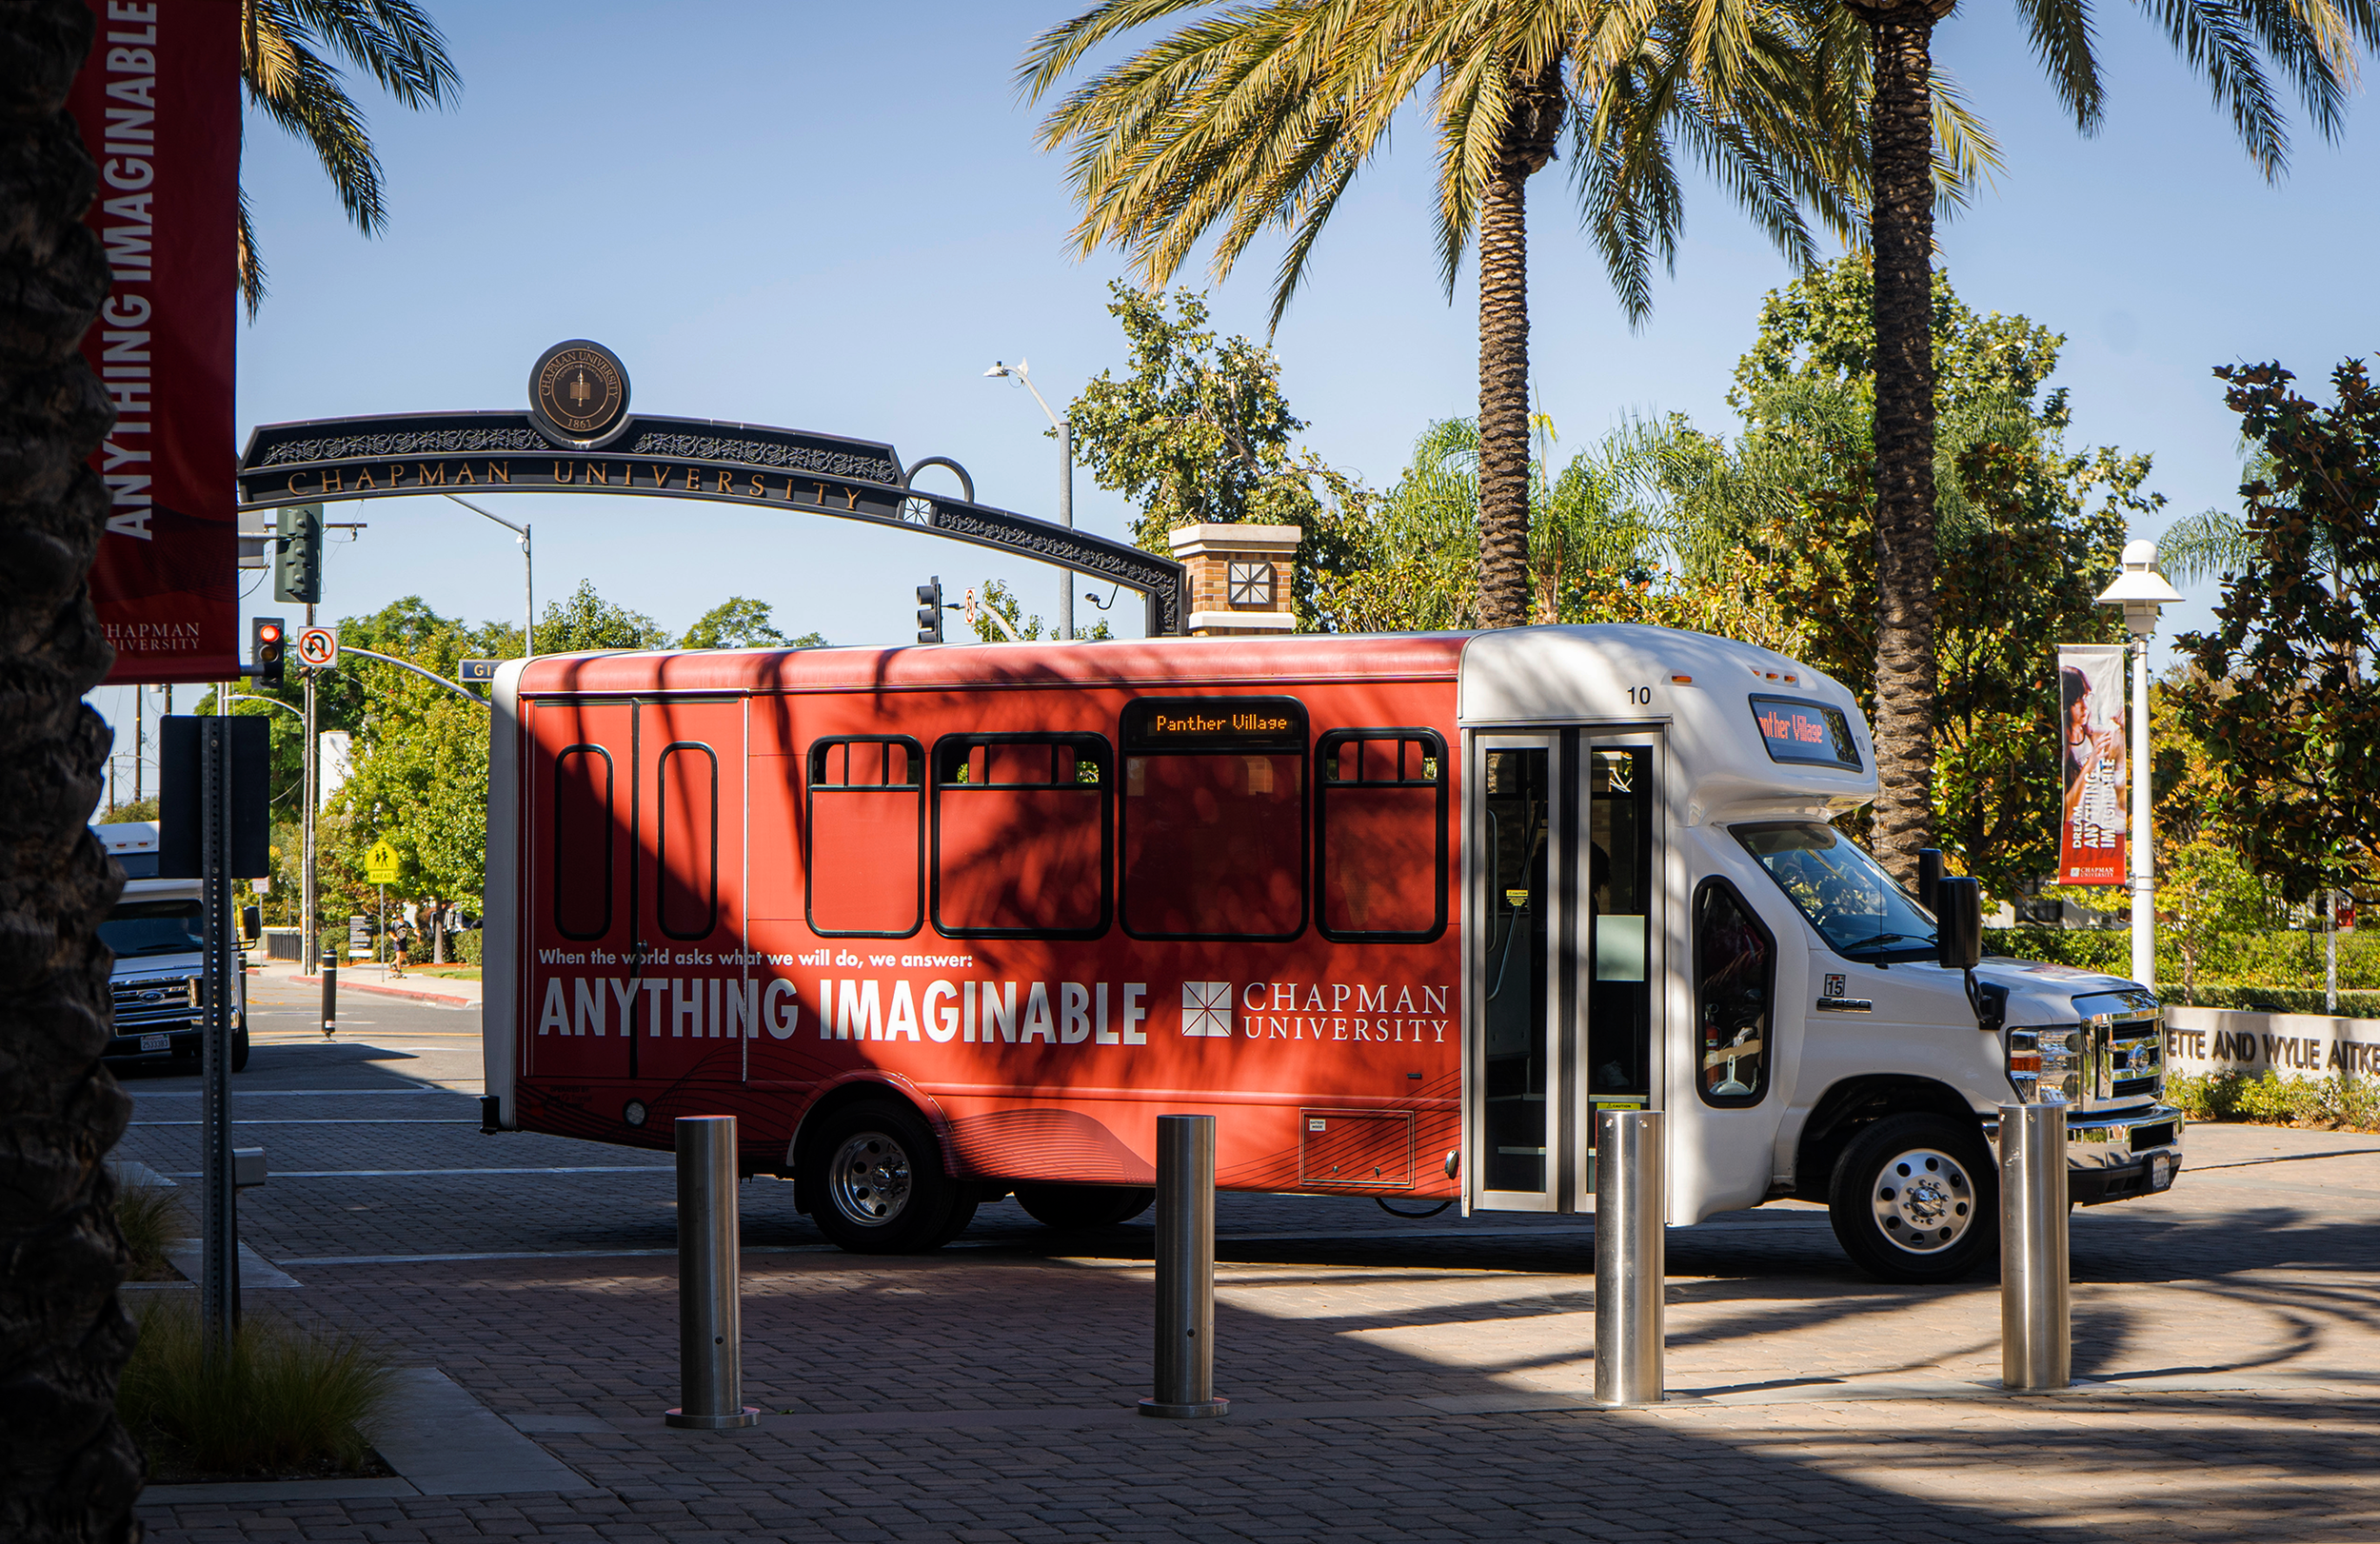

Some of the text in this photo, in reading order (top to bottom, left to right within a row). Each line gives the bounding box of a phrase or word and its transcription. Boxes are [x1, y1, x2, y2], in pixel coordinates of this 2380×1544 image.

[102, 0, 157, 541] ANYTHING IMAGINABLE
[541, 351, 577, 397] CHAPMAN
[579, 351, 619, 399] UNIVERSITY
[567, 419, 592, 428] 1861
[288, 461, 862, 510] CHAPMAN UNIVERSITY
[99, 623, 200, 638] HAPMAN
[106, 638, 200, 651] NIVERSITY
[1627, 686, 1652, 705] 10
[1157, 714, 1288, 732] Panther Village
[1792, 714, 1823, 743] Village
[2084, 771, 2099, 848] ANYTHING
[2100, 758, 2116, 848] IMAGINABLE
[2073, 806, 2083, 848] DREAM
[539, 948, 973, 969] When the world asks what we will do, we answer:
[1242, 982, 1449, 1015] CHAPMAN
[1828, 980, 1843, 996] 15
[538, 977, 1147, 1045] ANYTHING IMAGINABLE
[1243, 1016, 1449, 1042] UNIVERSITY
[2211, 1030, 2256, 1063] AND
[2261, 1033, 2321, 1071] WYLIE
